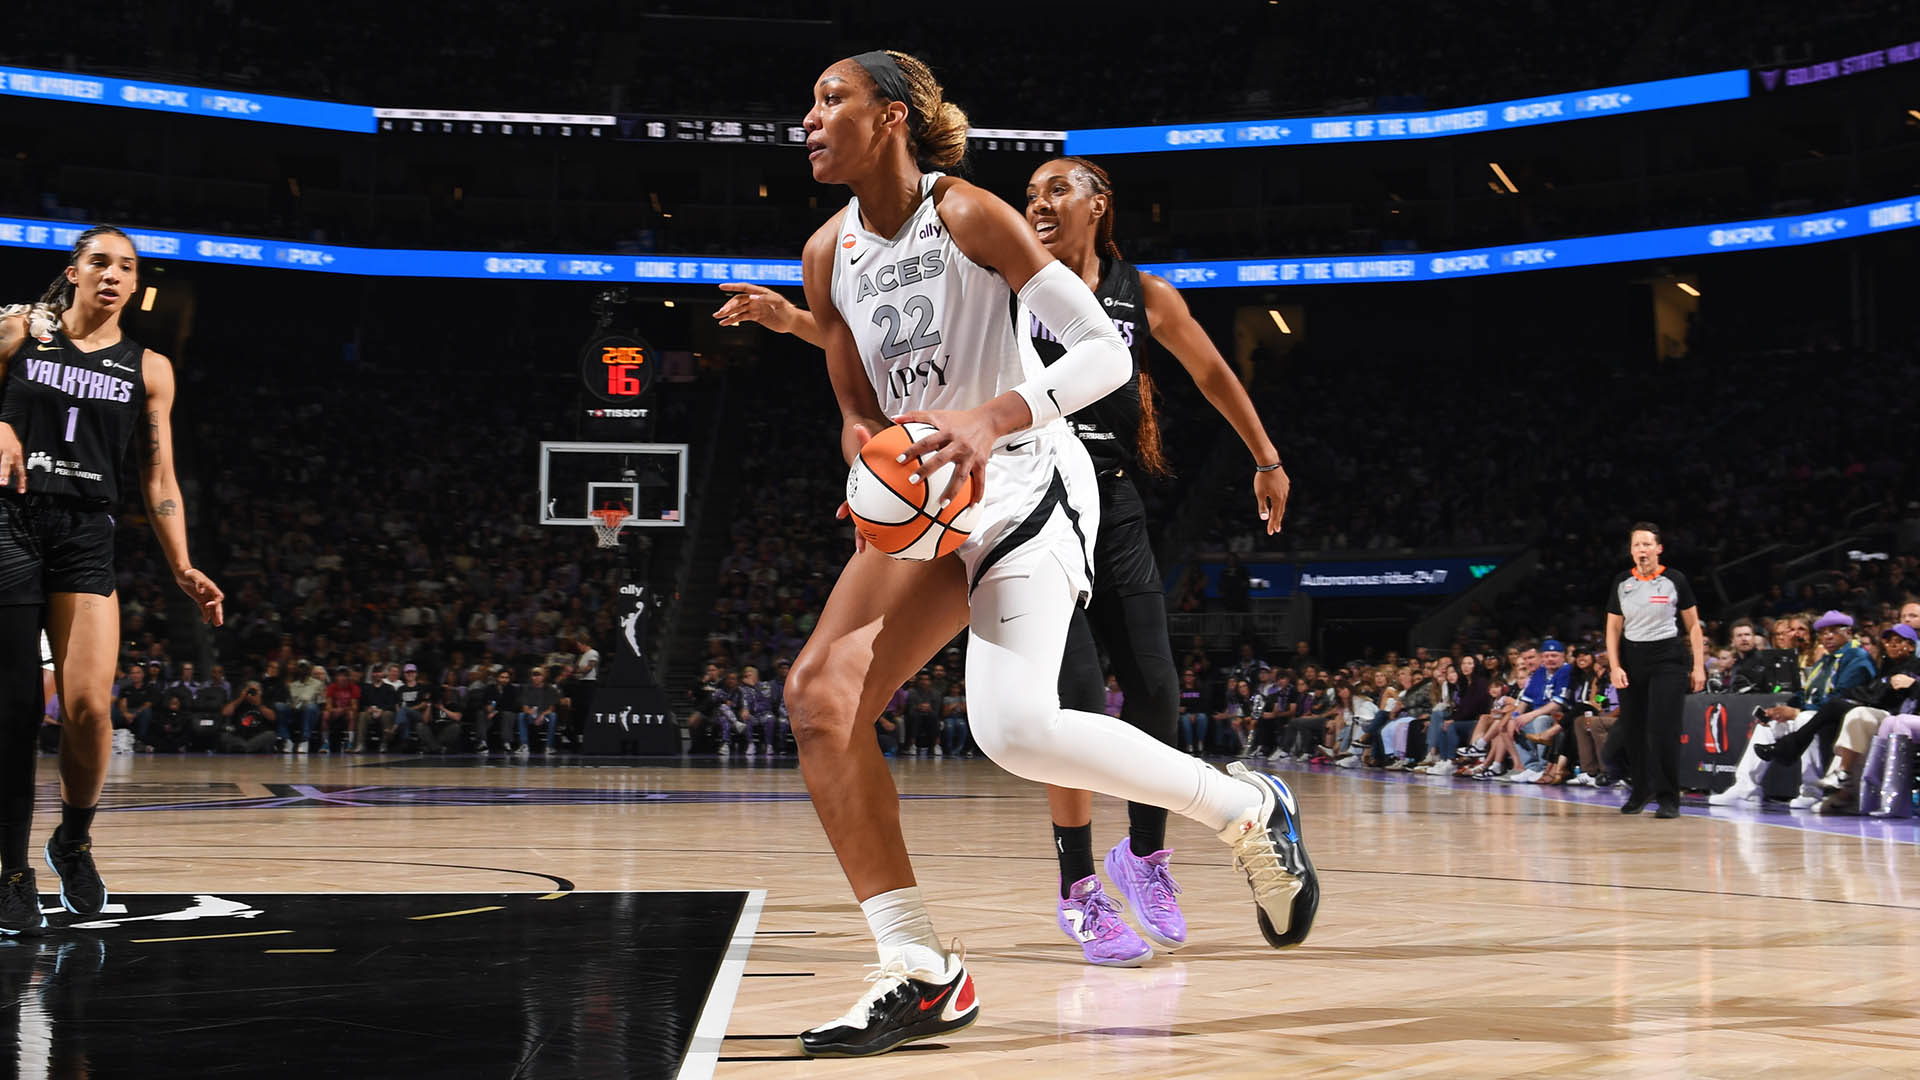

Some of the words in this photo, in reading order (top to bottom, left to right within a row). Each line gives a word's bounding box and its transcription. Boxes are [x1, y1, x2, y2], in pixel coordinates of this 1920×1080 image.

[919, 223, 942, 240] ally
[857, 249, 945, 303] ACES
[872, 295, 942, 360] 22
[26, 358, 134, 403] VALKYRIES
[608, 365, 640, 395] 16
[888, 355, 949, 399] IPSY
[65, 406, 79, 442] 1
[604, 409, 648, 418] TISSOT
[620, 584, 644, 597] ally
